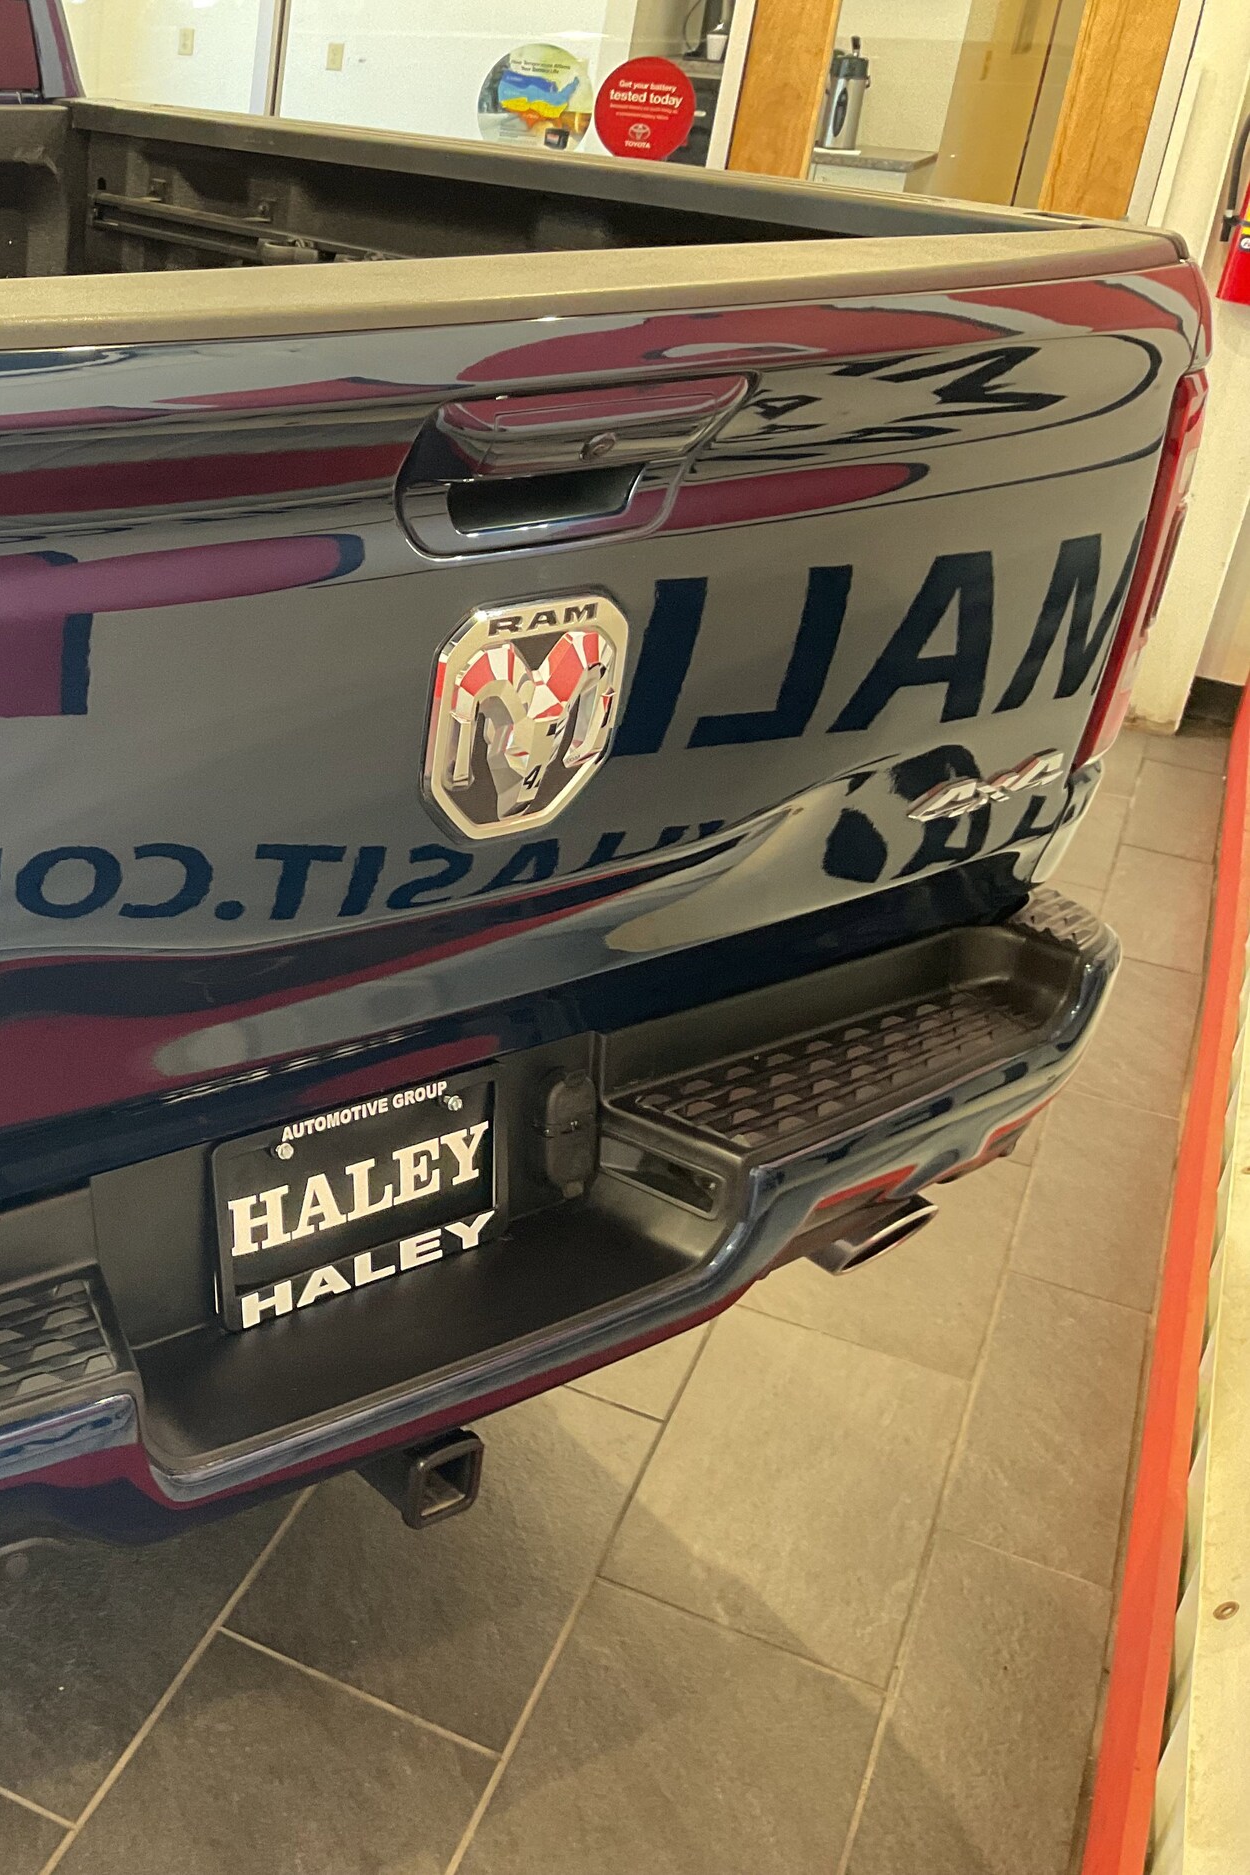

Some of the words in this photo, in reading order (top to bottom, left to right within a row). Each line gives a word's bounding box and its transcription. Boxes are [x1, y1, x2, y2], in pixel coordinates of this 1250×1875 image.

[609, 88, 648, 103] tested
[649, 92, 683, 109] today
[619, 79, 633, 88] Get
[633, 82, 649, 90] your
[650, 82, 677, 94] battery
[624, 140, 651, 149] TOYOTA
[488, 602, 599, 636] RAM
[281, 1097, 389, 1143] AUTOMOTIVE
[392, 1080, 448, 1110] GROUP
[227, 1120, 490, 1257] HALEY
[241, 1210, 496, 1330] HALEY
